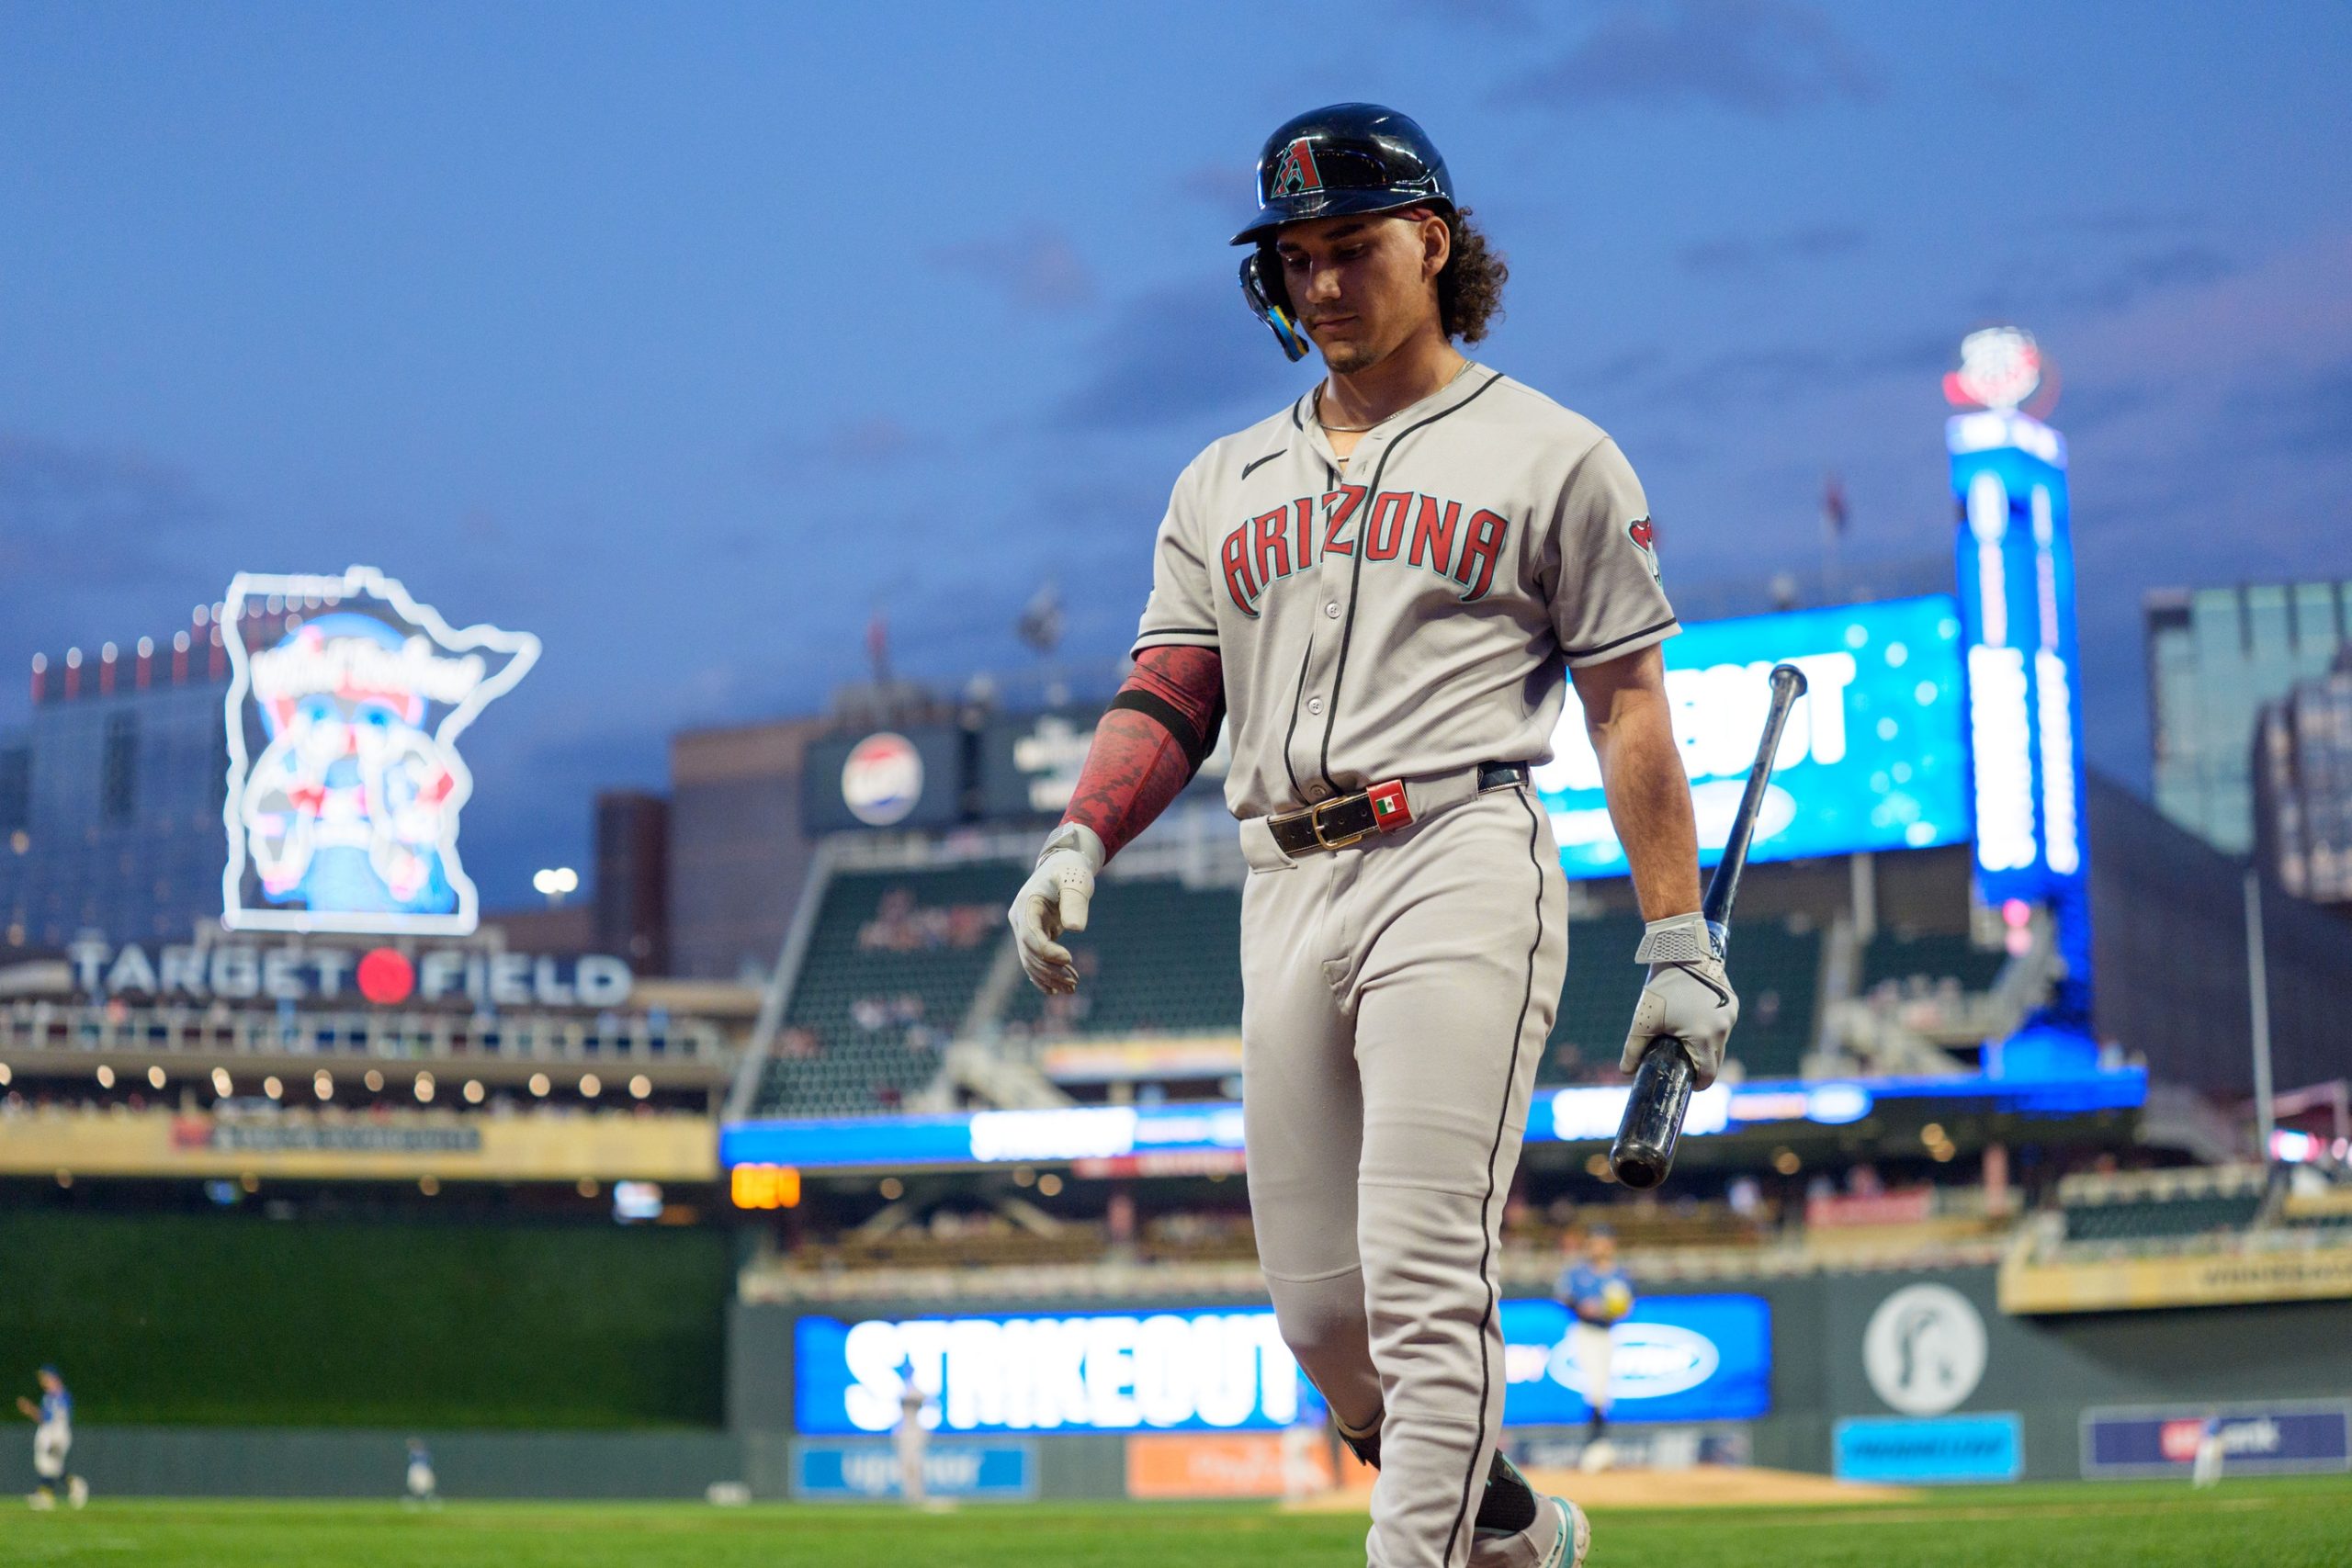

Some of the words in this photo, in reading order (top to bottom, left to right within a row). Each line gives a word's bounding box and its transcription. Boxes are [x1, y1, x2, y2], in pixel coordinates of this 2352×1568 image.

[1220, 481, 1511, 618] ARIZONA
[74, 942, 352, 998] TARGET
[419, 948, 635, 1007] FIELD
[843, 1314, 1297, 1432] STRIKEOUT
